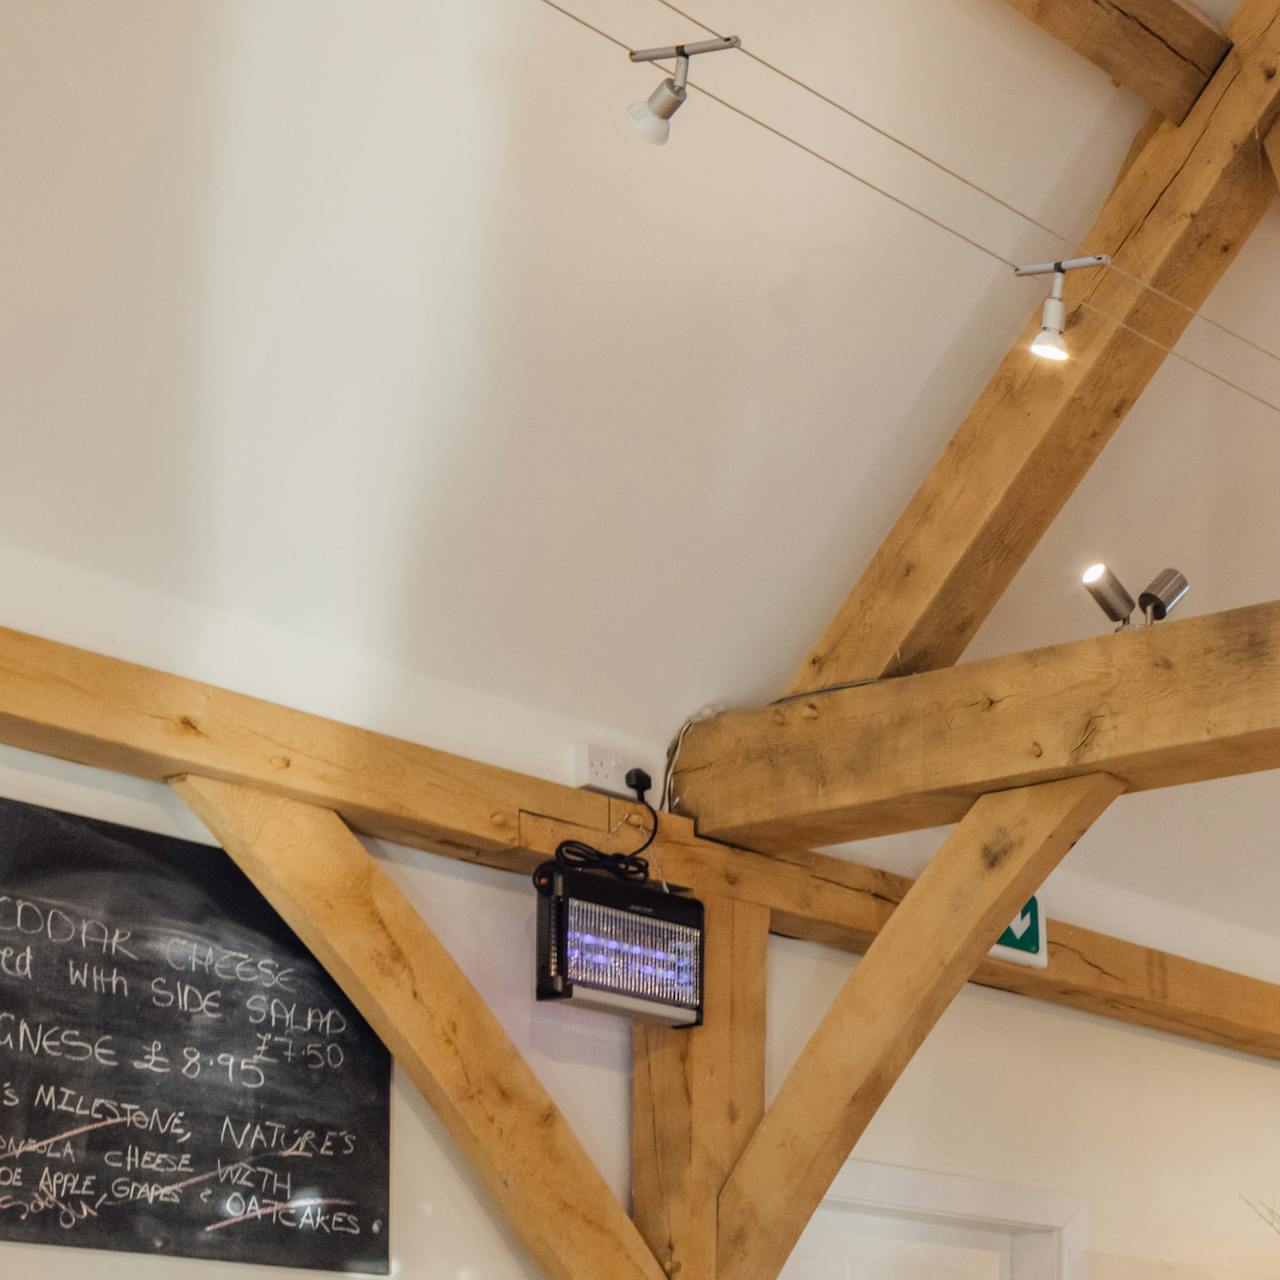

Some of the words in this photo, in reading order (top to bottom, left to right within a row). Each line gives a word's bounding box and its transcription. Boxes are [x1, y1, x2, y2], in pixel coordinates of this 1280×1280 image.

[166, 937, 297, 993] CHEESE
[151, 976, 222, 1018] SIDE
[246, 994, 346, 1034] SALAD
[104, 1145, 193, 1172] CHEESE
[217, 1158, 291, 1199] WITH
